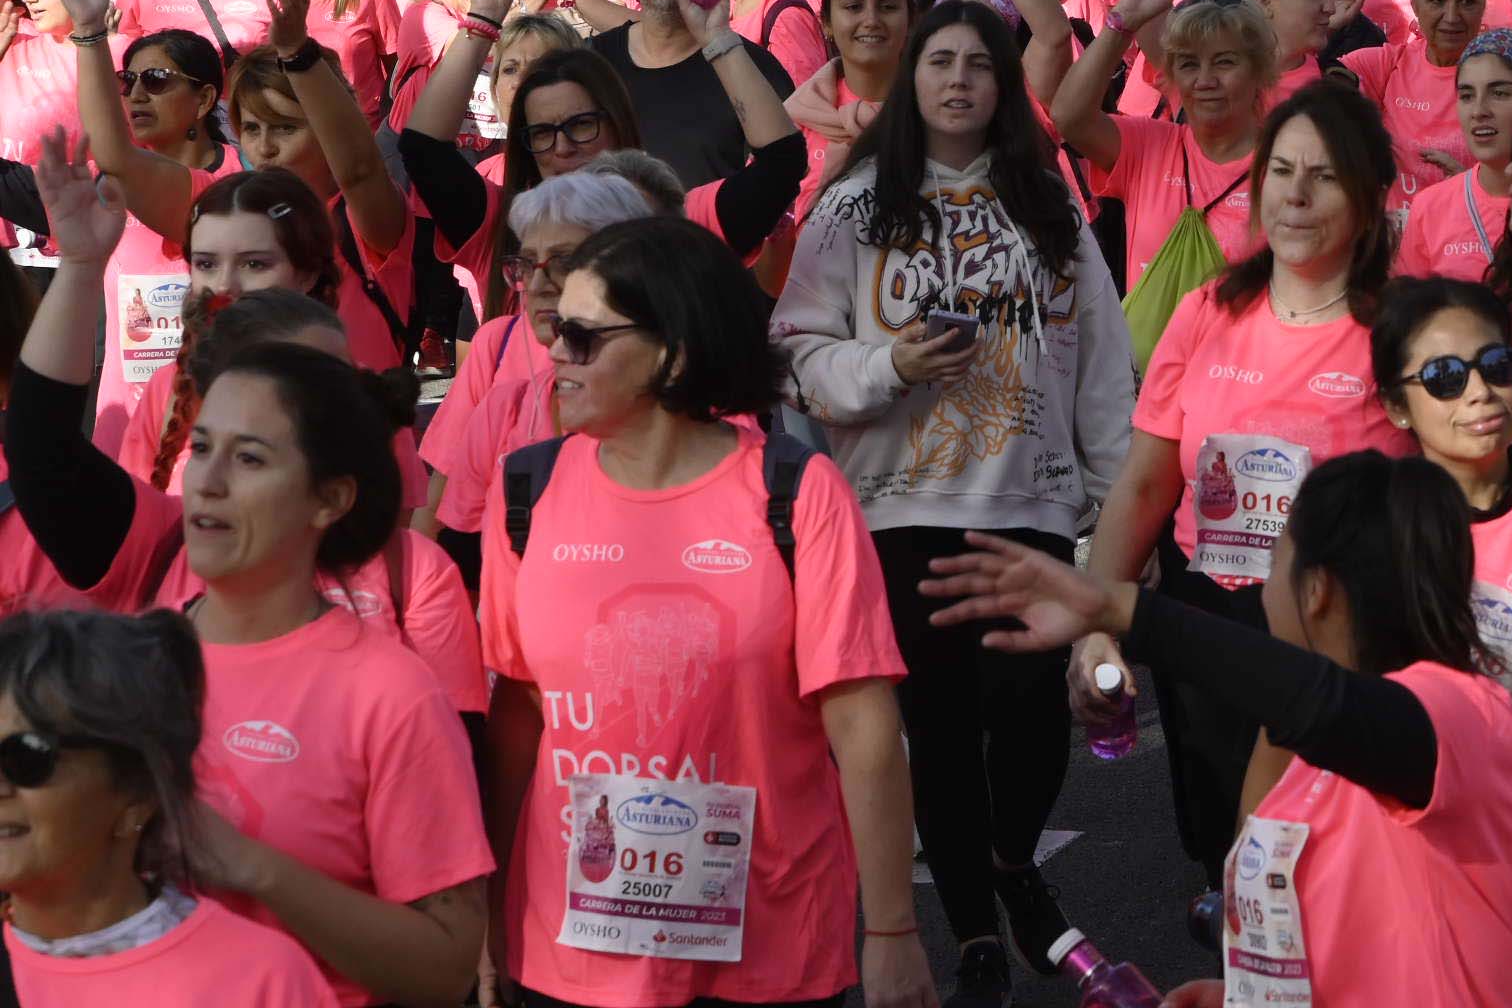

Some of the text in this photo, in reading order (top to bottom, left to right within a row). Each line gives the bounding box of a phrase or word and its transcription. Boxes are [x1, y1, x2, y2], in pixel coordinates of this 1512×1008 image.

[1241, 459, 1293, 477] ASTURIANA
[1242, 492, 1292, 515] 016
[1204, 532, 1246, 544] CARRERA
[1248, 536, 1261, 545] DE
[552, 543, 625, 563] OYSHO
[1200, 551, 1247, 566] OYSHO
[545, 690, 595, 732] TU
[622, 807, 692, 828] ASTURIANA
[705, 808, 741, 820] SUMA
[620, 847, 684, 876] 016
[621, 880, 673, 899] 25007
[579, 897, 623, 913] CARRERA
[625, 905, 639, 915] DE
[642, 907, 658, 917] LA
[659, 908, 697, 920] MUJER
[573, 921, 622, 941] OYSHO
[669, 931, 728, 947] Santander
